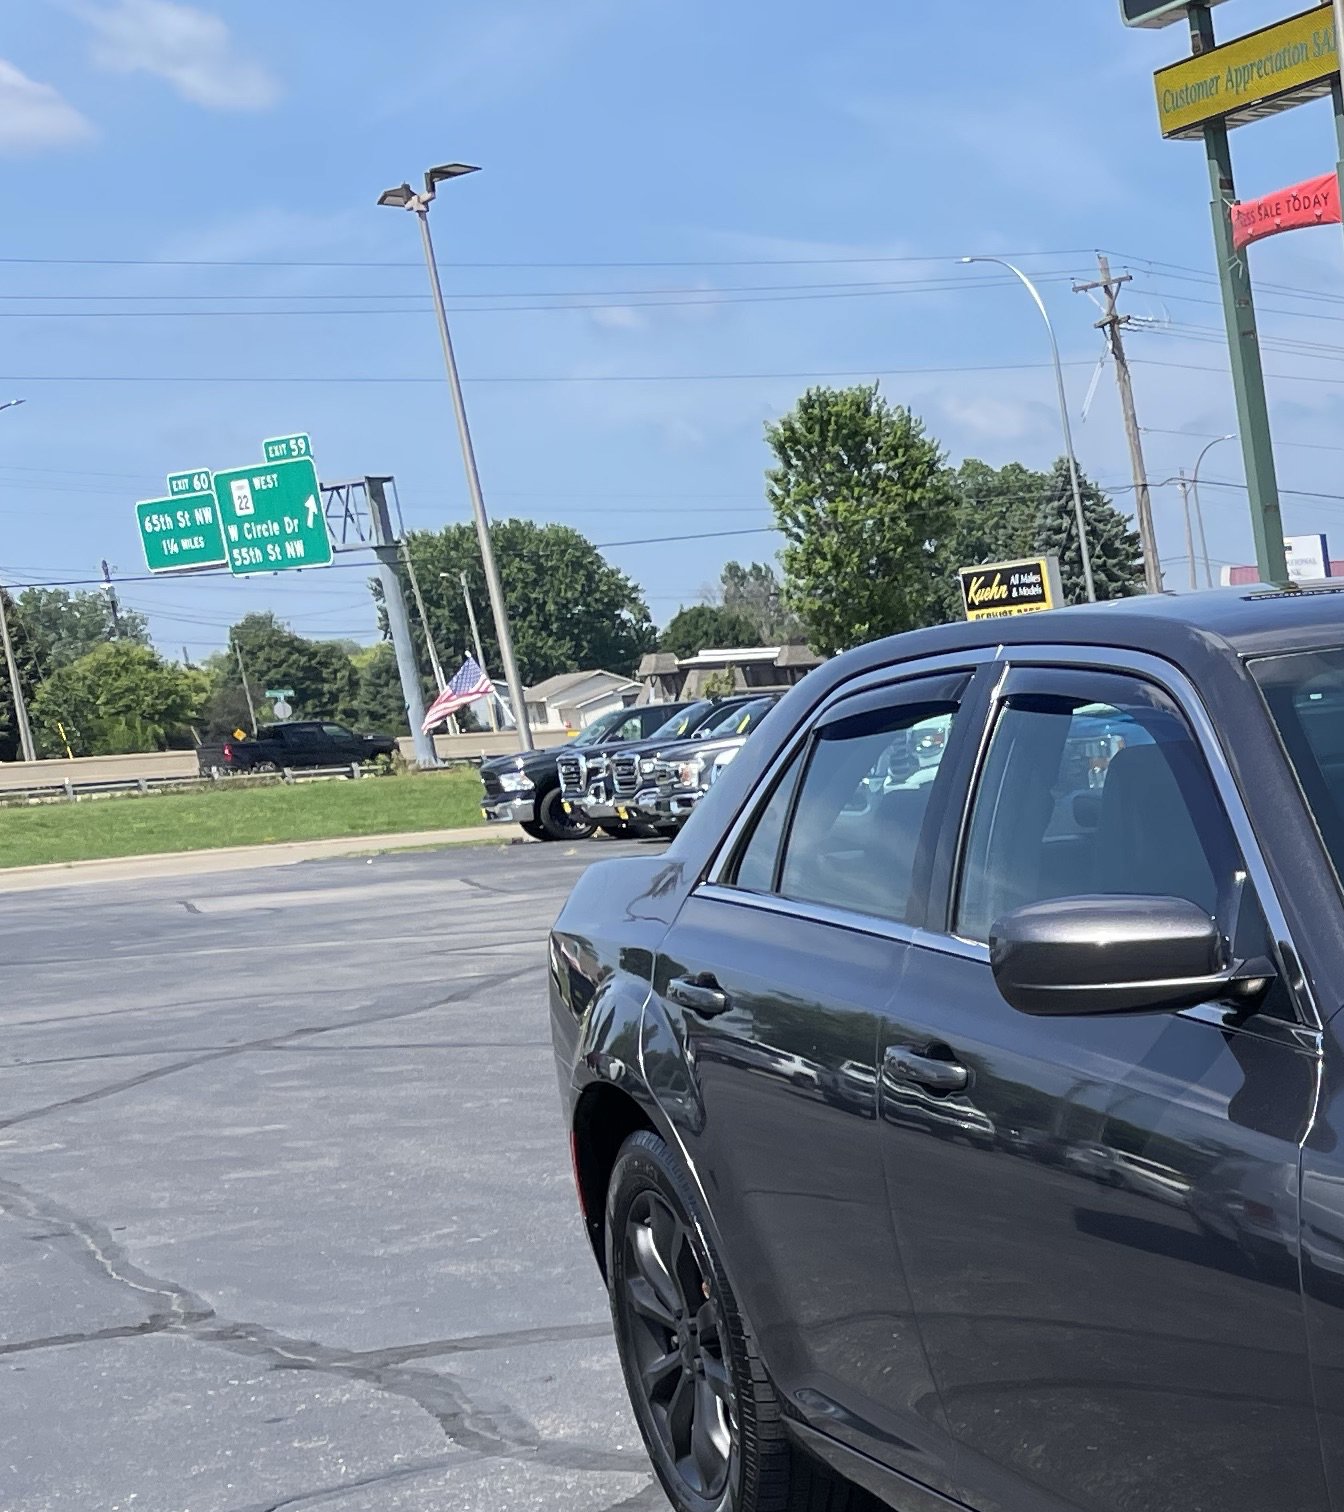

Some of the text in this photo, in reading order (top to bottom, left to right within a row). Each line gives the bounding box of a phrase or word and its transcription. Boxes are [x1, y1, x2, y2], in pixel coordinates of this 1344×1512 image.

[1163, 74, 1220, 114] Customer
[1225, 41, 1309, 95] Appreciation
[1257, 202, 1281, 221] SALE
[1286, 191, 1330, 213] TODAY
[268, 437, 306, 458] EXIT 59
[172, 473, 209, 492] EXIT 60
[252, 473, 279, 491] WEST
[237, 494, 251, 511] 22
[143, 506, 214, 533] 65th St NW
[227, 516, 299, 543] W Circle Dr
[181, 536, 205, 551] MILES
[232, 539, 305, 567] 55th St NW
[967, 572, 1009, 606] Kuehn
[1009, 573, 1020, 585] All
[1011, 587, 1018, 598] &
